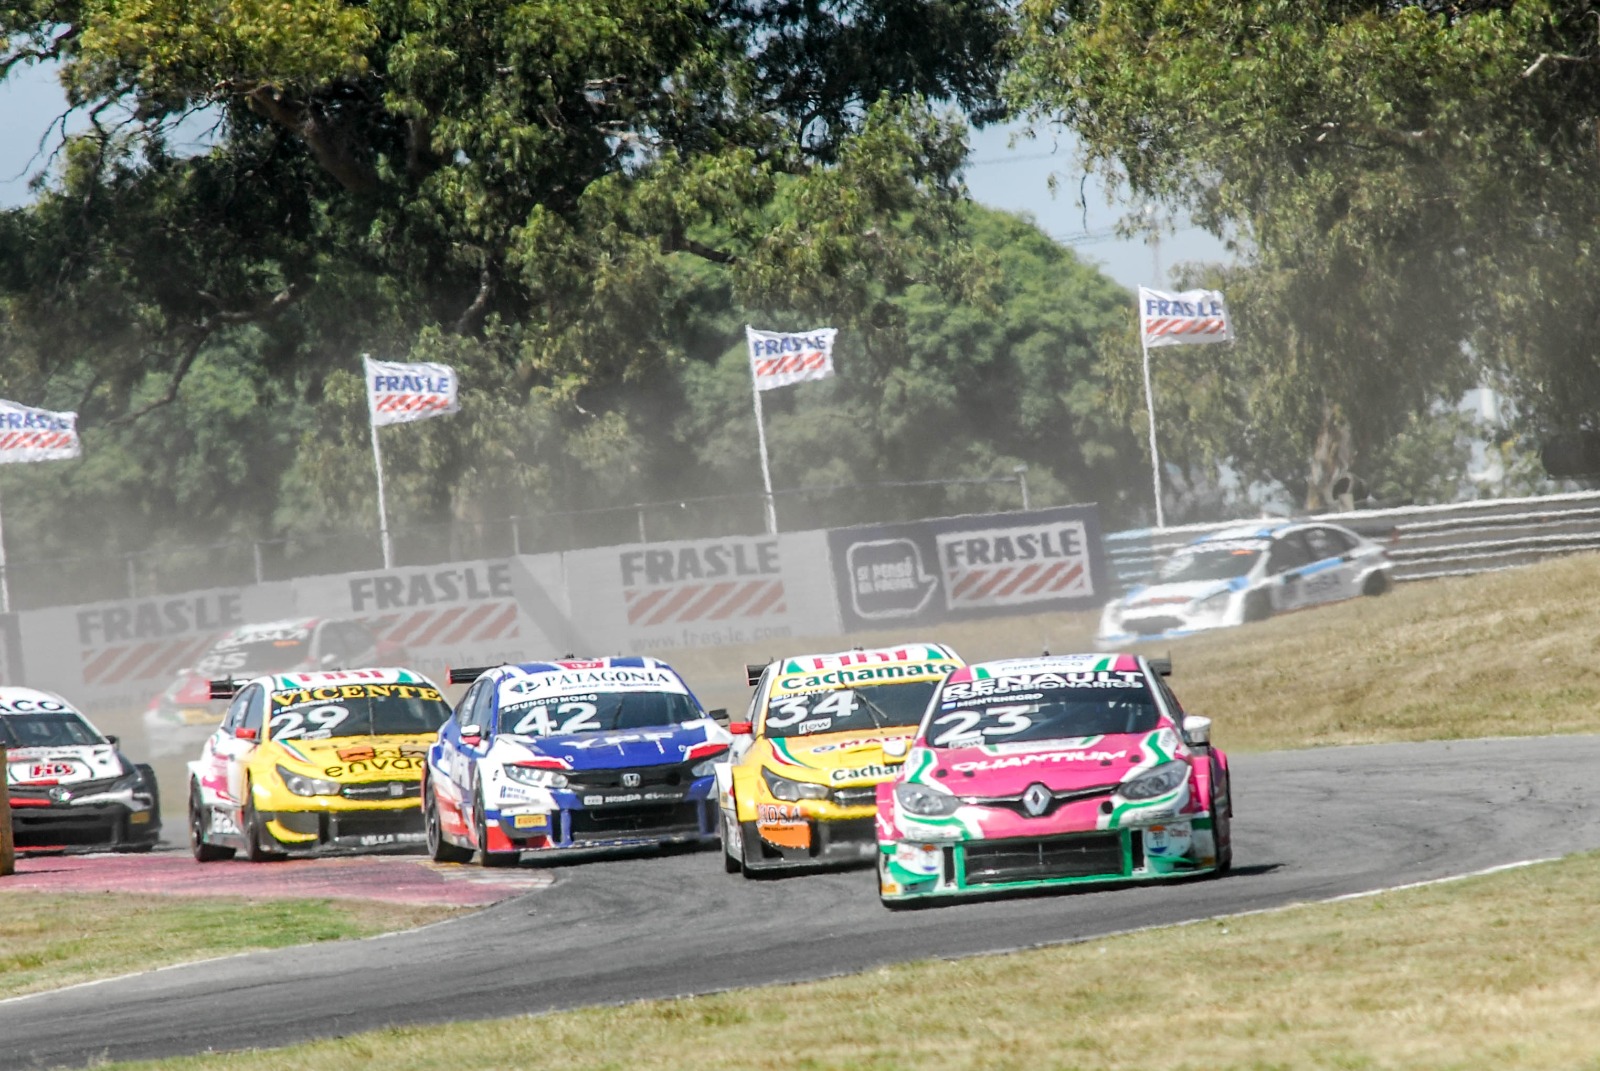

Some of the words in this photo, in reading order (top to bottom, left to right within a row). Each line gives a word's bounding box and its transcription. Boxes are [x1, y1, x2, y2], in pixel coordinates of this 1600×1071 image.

[544, 670, 670, 688] PATAGONIA
[781, 663, 957, 690] Cachamate
[942, 670, 1144, 698] RENAULT
[271, 684, 443, 706] VICENTE
[956, 692, 1044, 708] MONTENEGRO
[513, 701, 602, 737] 42
[765, 690, 859, 728] 34
[269, 705, 350, 742] 29
[799, 719, 830, 733] flow
[933, 705, 1032, 747] 23
